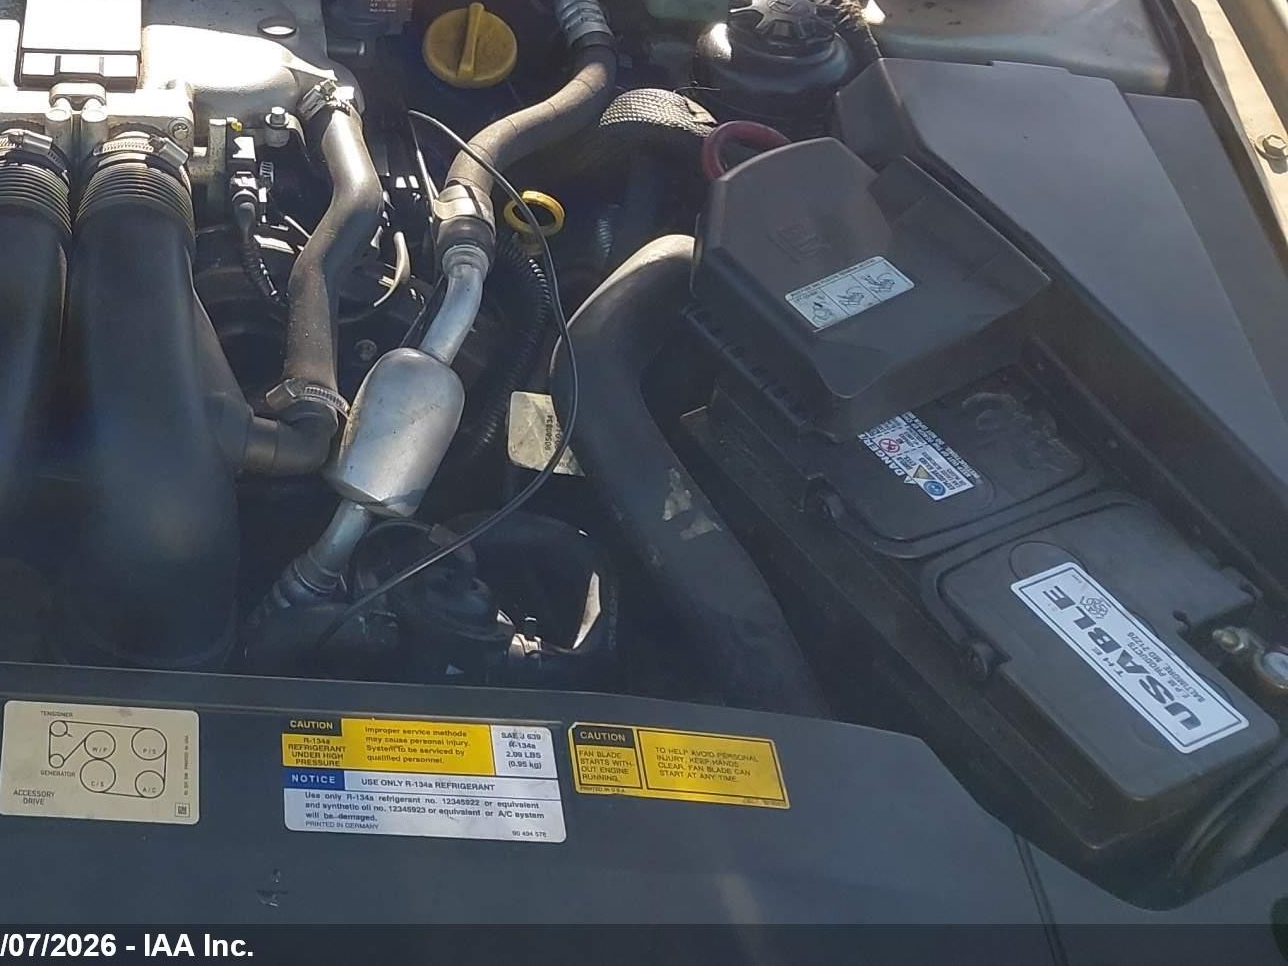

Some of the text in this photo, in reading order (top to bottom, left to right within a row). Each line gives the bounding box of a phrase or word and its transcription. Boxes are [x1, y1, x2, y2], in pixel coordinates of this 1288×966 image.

[1043, 586, 1201, 730] USABLE
[1127, 642, 1168, 677] PRODUCTS
[1092, 648, 1124, 678] THE
[40, 710, 73, 718] TENSIONER
[289, 720, 333, 730] CAUTION
[365, 726, 400, 734] Improper
[433, 729, 467, 737] methods
[410, 737, 444, 745] personal
[580, 731, 626, 742] CAUTION
[288, 743, 347, 752] REFRIGERANT
[508, 741, 536, 749] R-134a
[366, 744, 395, 752] System
[455, 748, 465, 756] by
[323, 752, 344, 760] HIGH
[367, 754, 400, 762] qualified
[525, 751, 541, 759] LBS
[597, 751, 621, 759] BLADE
[692, 750, 715, 758] AVOID
[717, 752, 759, 762] PERSONAL
[295, 758, 341, 766] PRESSURE
[529, 760, 541, 770] kg)
[581, 758, 609, 766] STARTS
[690, 756, 709, 764] KEEP
[712, 760, 739, 768] HANDS
[600, 766, 629, 774] ENGINE
[659, 770, 684, 778] START
[707, 766, 732, 774] BLADE
[292, 774, 336, 784] NOTICE
[361, 778, 495, 791] USE ONLY R-134a REFRIGERANT
[13, 789, 55, 798] ACCESSORY
[23, 797, 44, 805] DRIVE
[305, 791, 320, 799] Use
[325, 793, 341, 801] only
[379, 795, 420, 804] refrigerant
[497, 801, 539, 809] equivalent
[323, 802, 359, 811] synthetic
[439, 808, 480, 816] equivalent
[498, 810, 513, 818] A/C
[515, 812, 545, 820] system
[338, 813, 378, 821] damaged.
[345, 822, 379, 830] GERMANY
